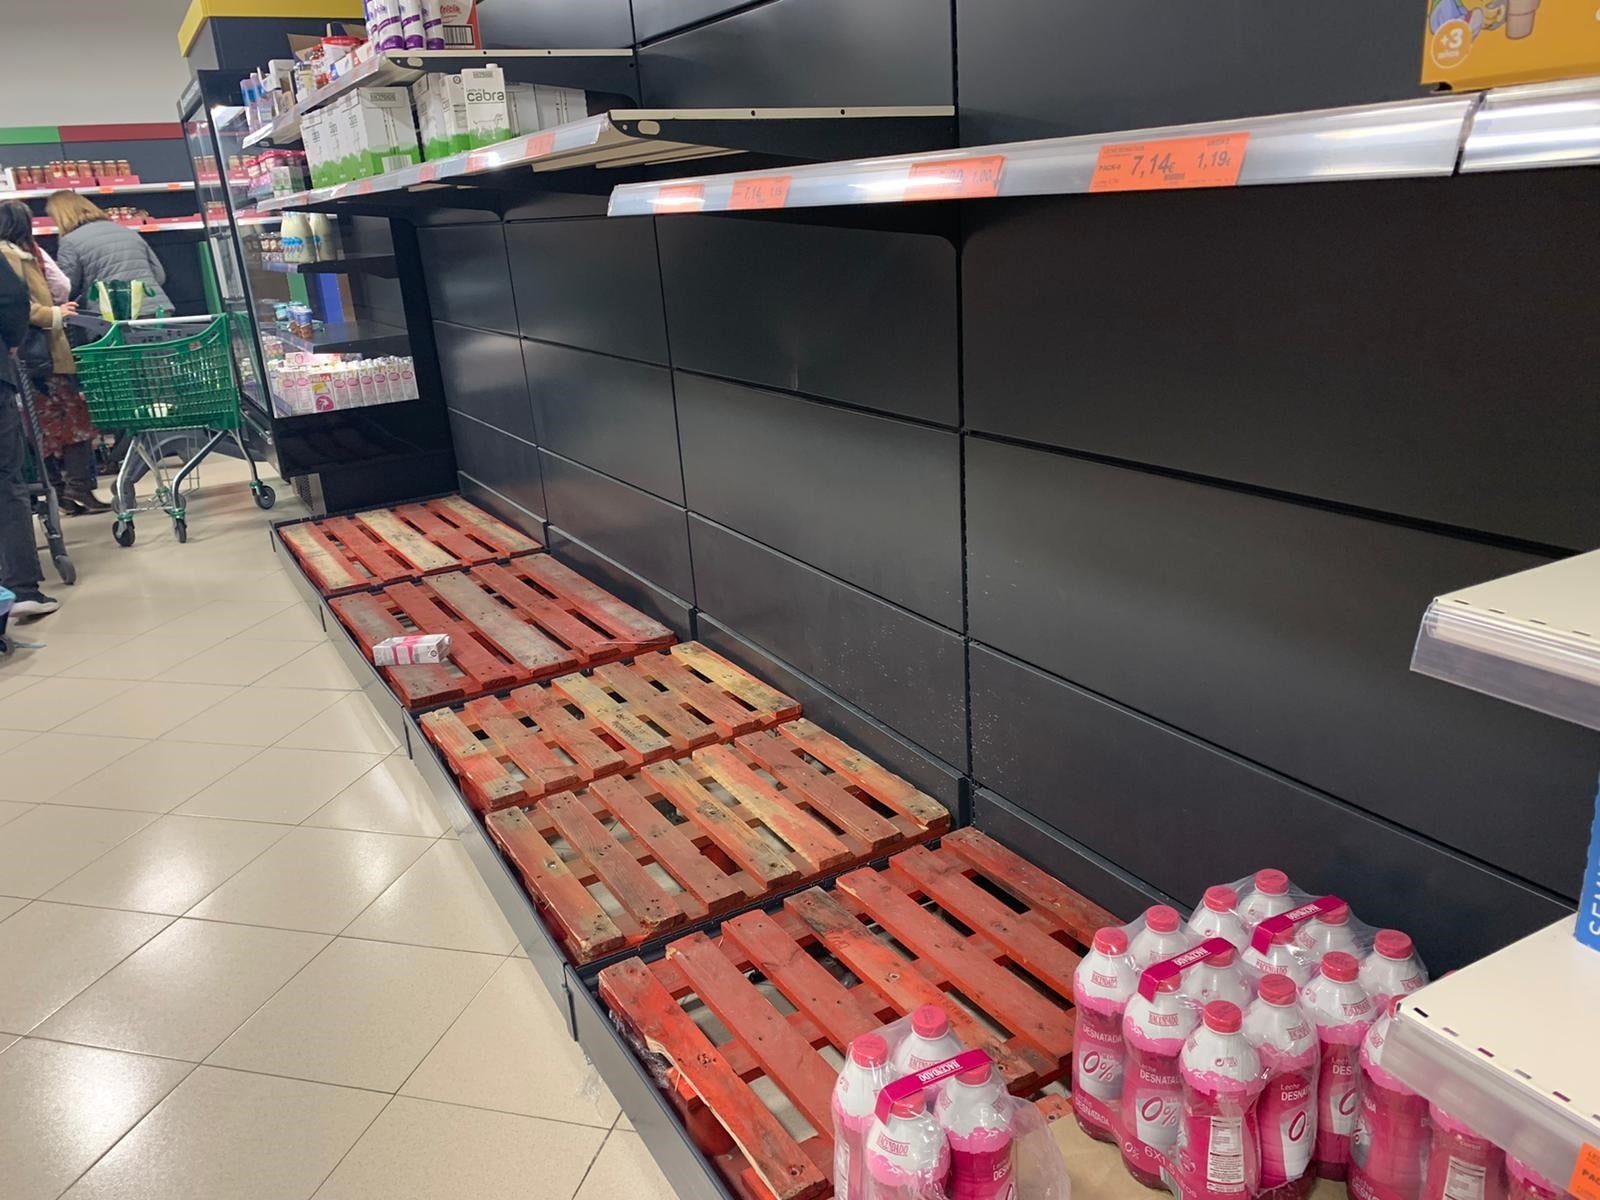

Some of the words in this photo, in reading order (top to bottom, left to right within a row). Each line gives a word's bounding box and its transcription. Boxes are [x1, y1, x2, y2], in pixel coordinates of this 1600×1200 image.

[467, 88, 505, 102] cabra
[918, 1059, 961, 1082] HACENDADO
[1083, 1051, 1113, 1081] 0%
[1141, 1096, 1178, 1127] 0%
